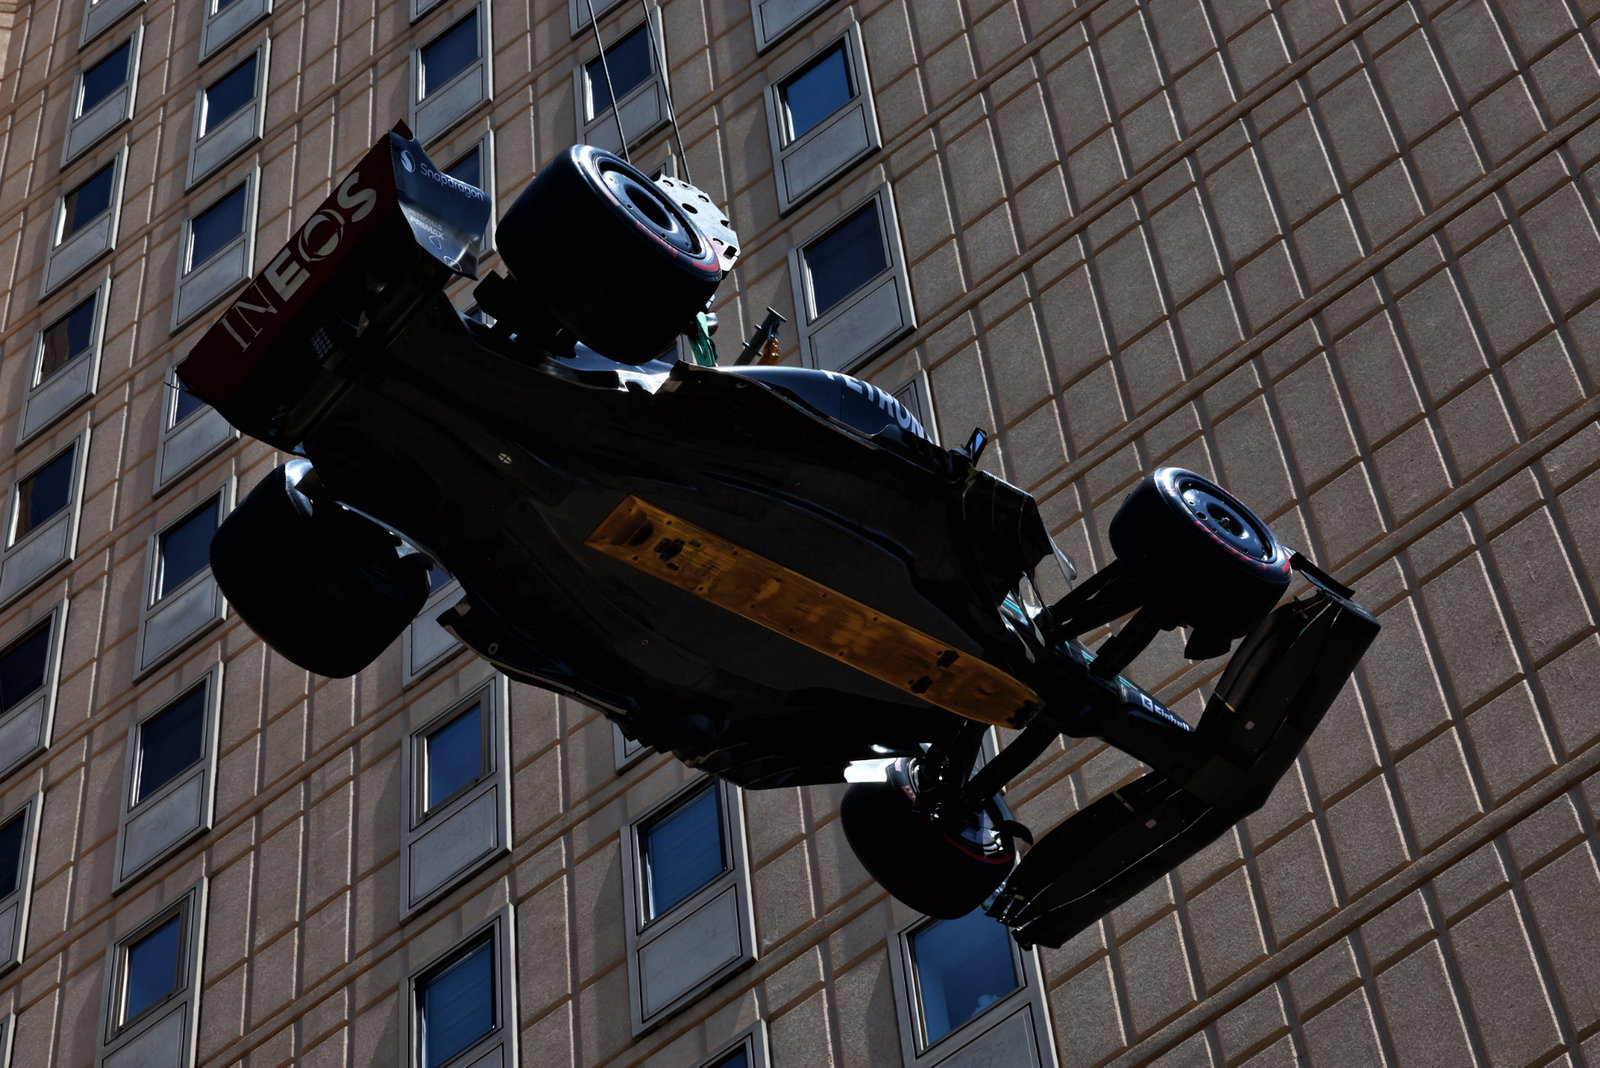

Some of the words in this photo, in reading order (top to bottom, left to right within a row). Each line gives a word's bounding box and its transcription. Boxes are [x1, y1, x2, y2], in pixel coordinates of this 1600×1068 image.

[420, 163, 484, 202] Snapdragon
[218, 170, 378, 353] INEOS
[1154, 705, 1190, 732] Einhell
